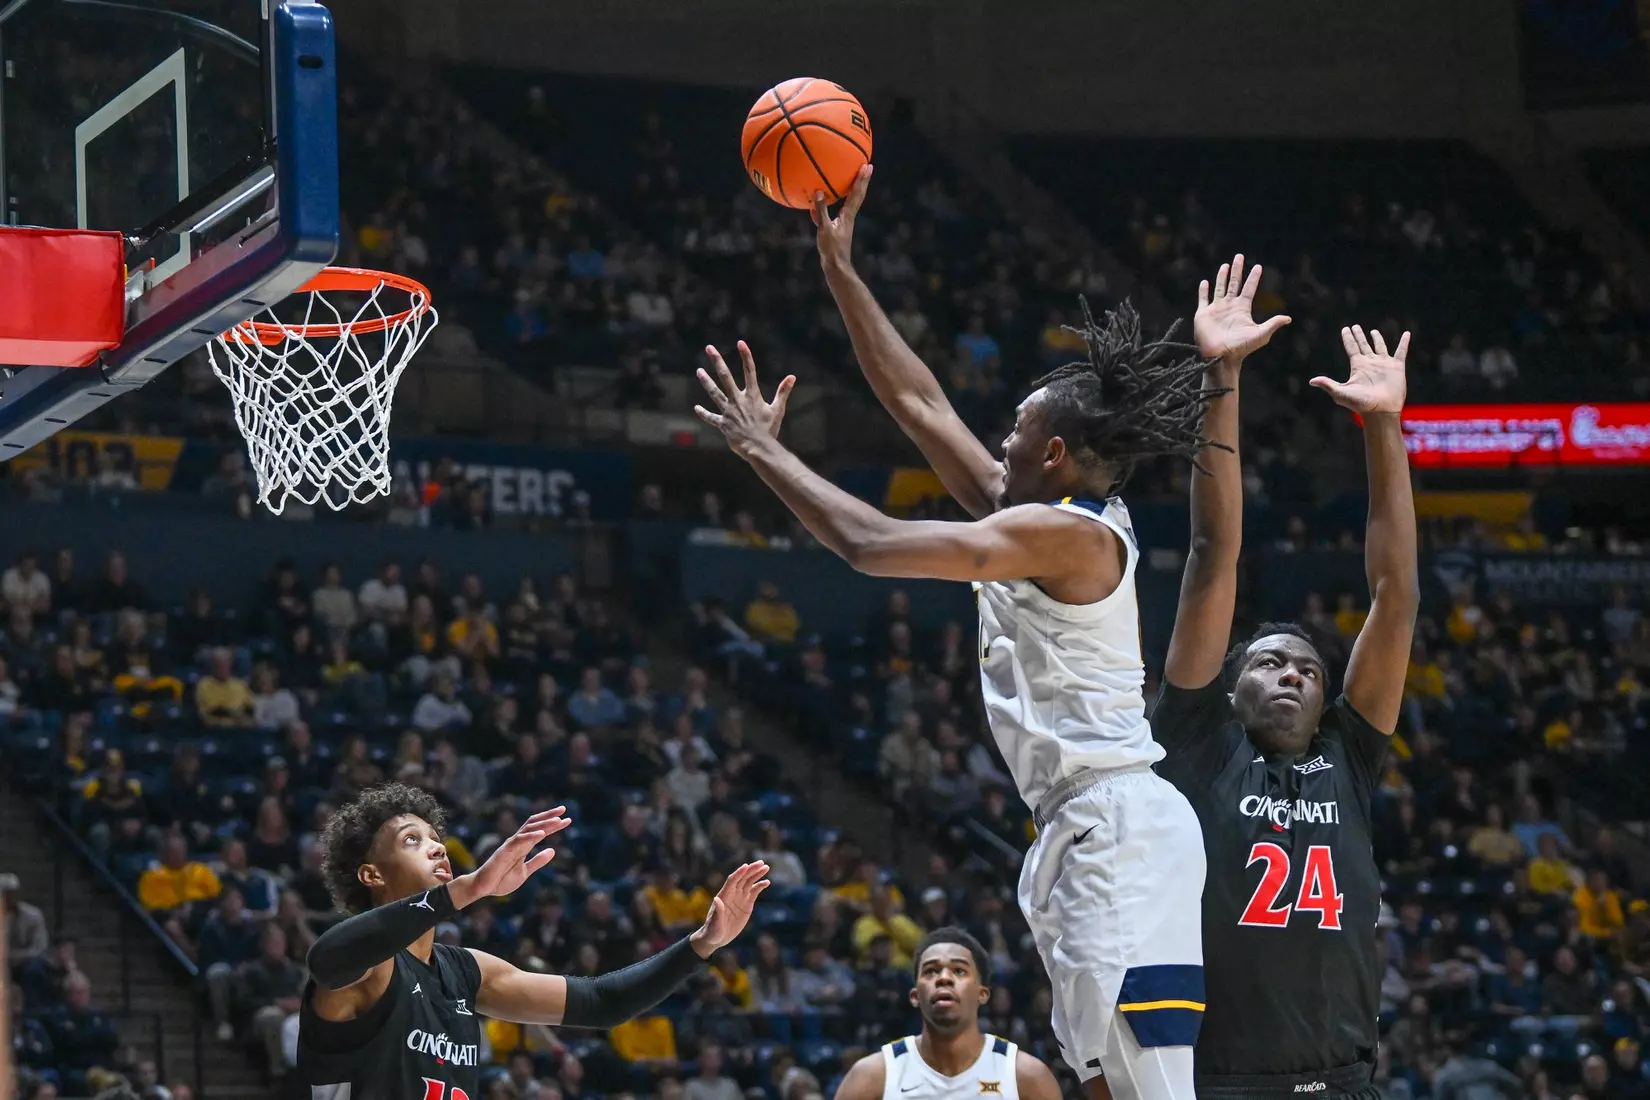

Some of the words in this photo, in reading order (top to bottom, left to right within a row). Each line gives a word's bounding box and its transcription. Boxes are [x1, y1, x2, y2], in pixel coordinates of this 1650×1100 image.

[1239, 795, 1340, 829] CINCINNATI
[1237, 841, 1344, 931] 24
[406, 1028, 478, 1067] CINCINATI
